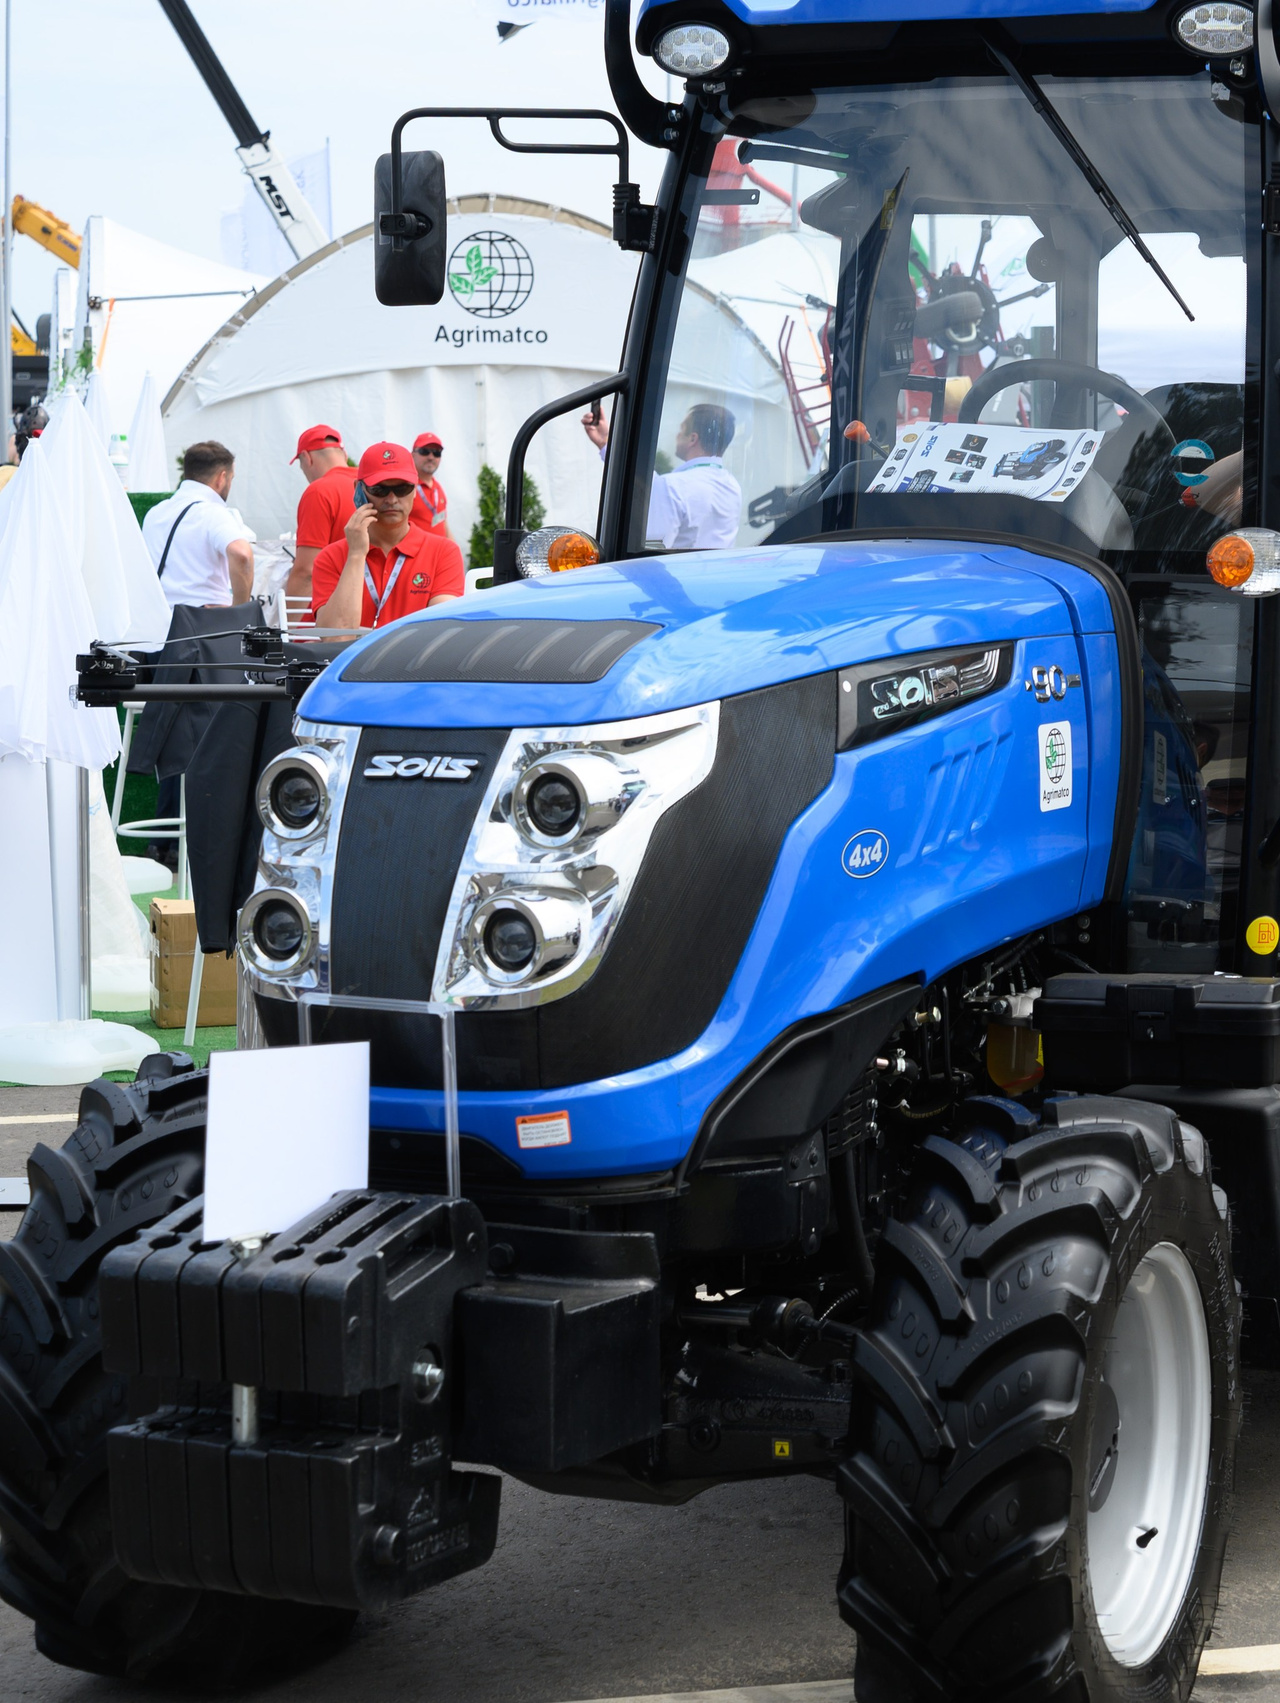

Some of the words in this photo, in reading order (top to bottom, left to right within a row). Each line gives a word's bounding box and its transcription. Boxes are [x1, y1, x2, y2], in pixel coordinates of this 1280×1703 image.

[259, 175, 295, 221] MST
[435, 325, 548, 348] Agrimatco
[1032, 664, 1067, 703] 90
[1042, 787, 1069, 804] Agrimatco
[849, 838, 882, 868] 4x4
